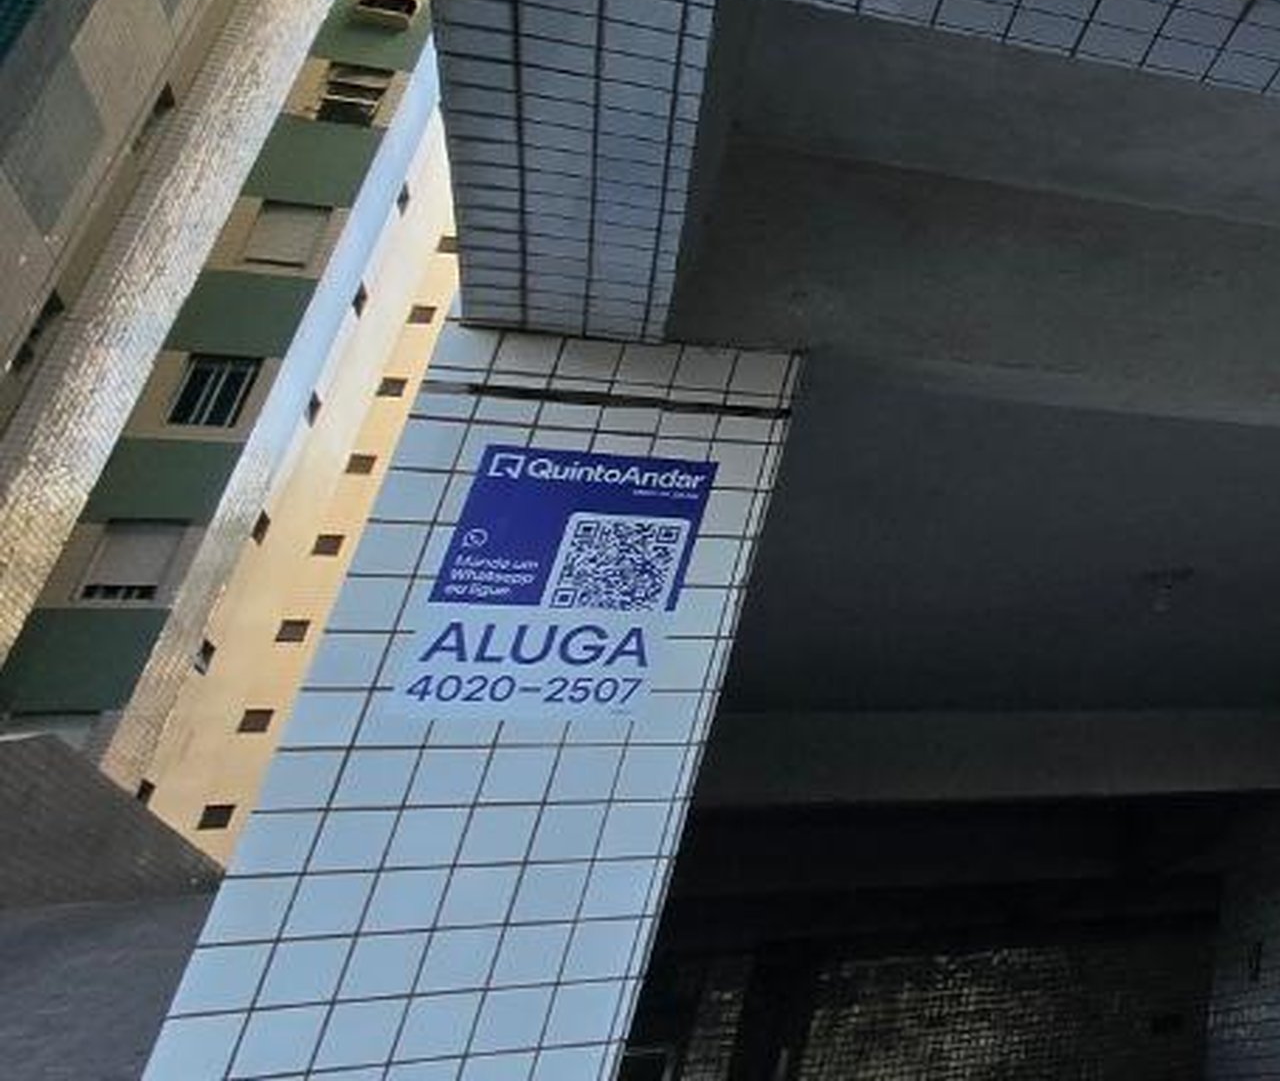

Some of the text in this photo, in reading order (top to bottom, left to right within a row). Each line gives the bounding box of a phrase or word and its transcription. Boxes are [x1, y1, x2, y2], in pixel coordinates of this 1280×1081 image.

[527, 457, 706, 491] QuintoAndar
[418, 622, 650, 668] ALUGA
[406, 674, 645, 704] 4020-2507
